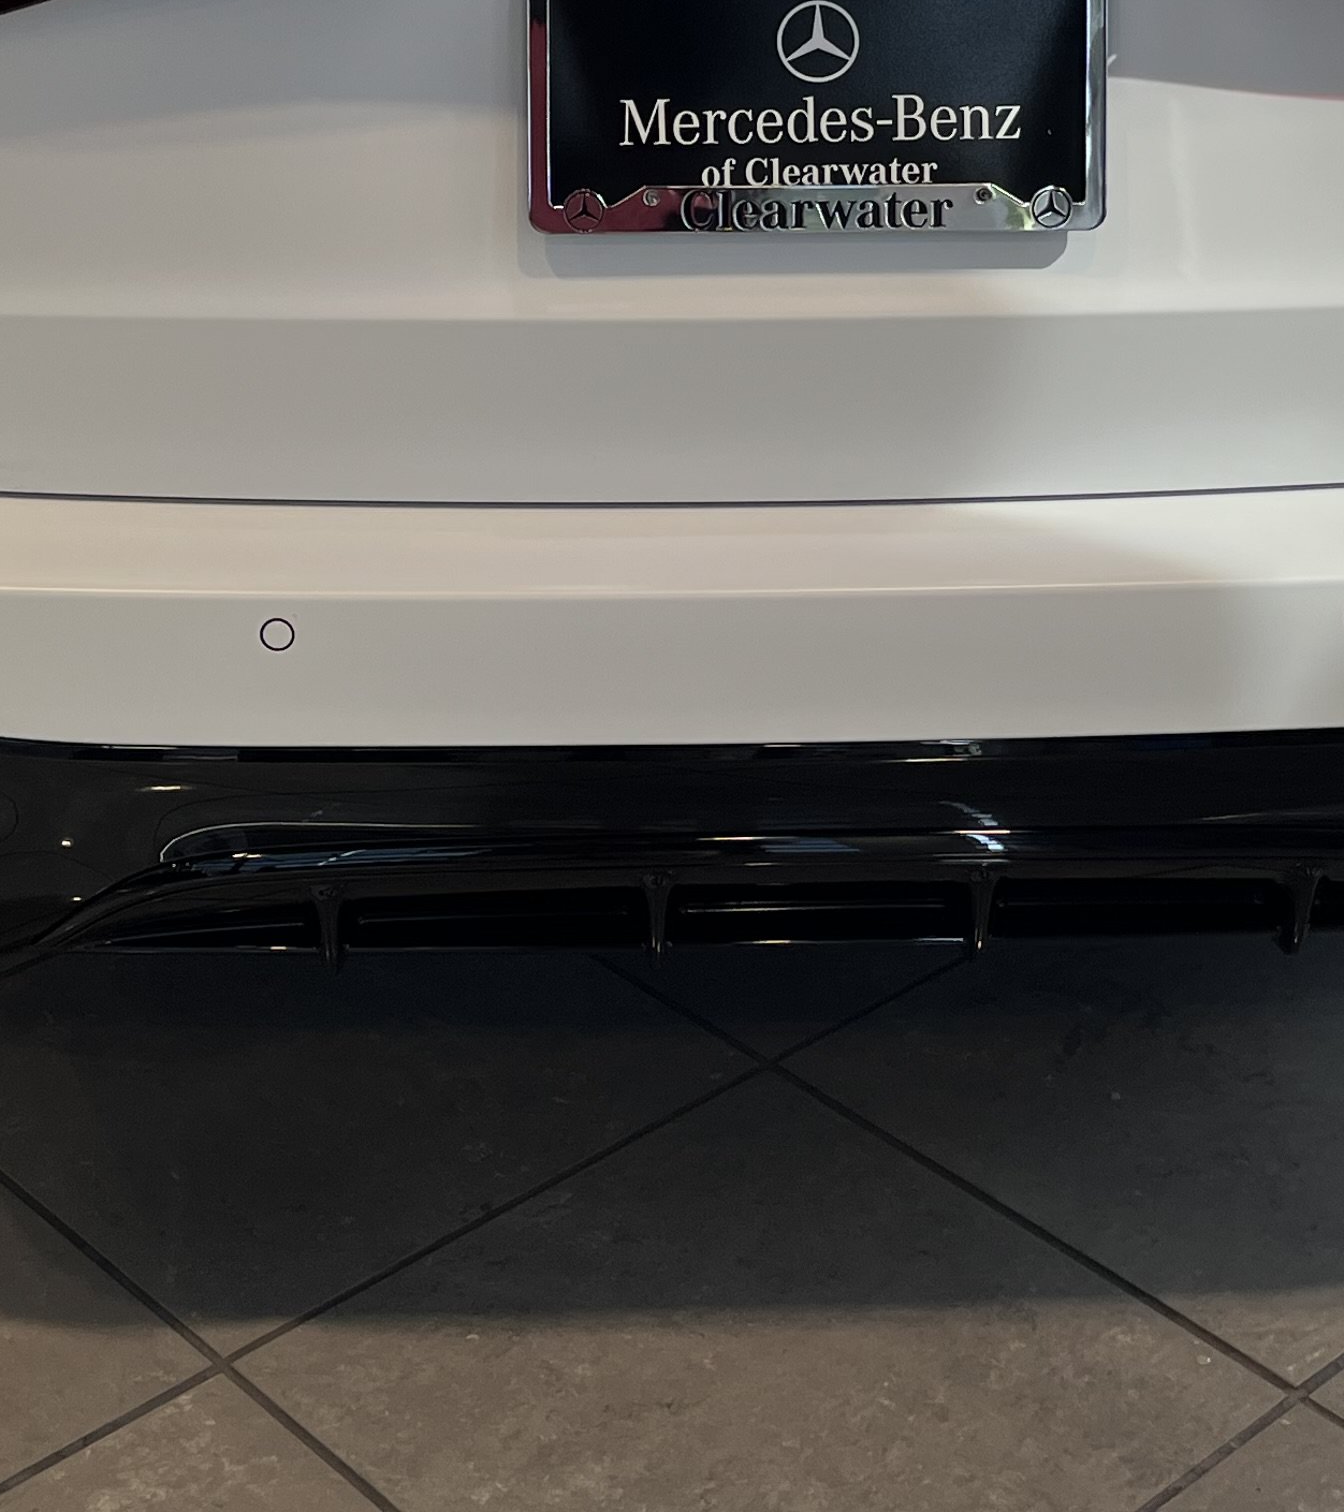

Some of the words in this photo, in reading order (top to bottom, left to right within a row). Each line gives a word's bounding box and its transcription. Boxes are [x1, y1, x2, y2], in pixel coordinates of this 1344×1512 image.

[618, 93, 1022, 147] Mercedes-Benz
[701, 157, 736, 188] of
[744, 155, 939, 187] Clearwater
[680, 188, 954, 232] Clearwater
